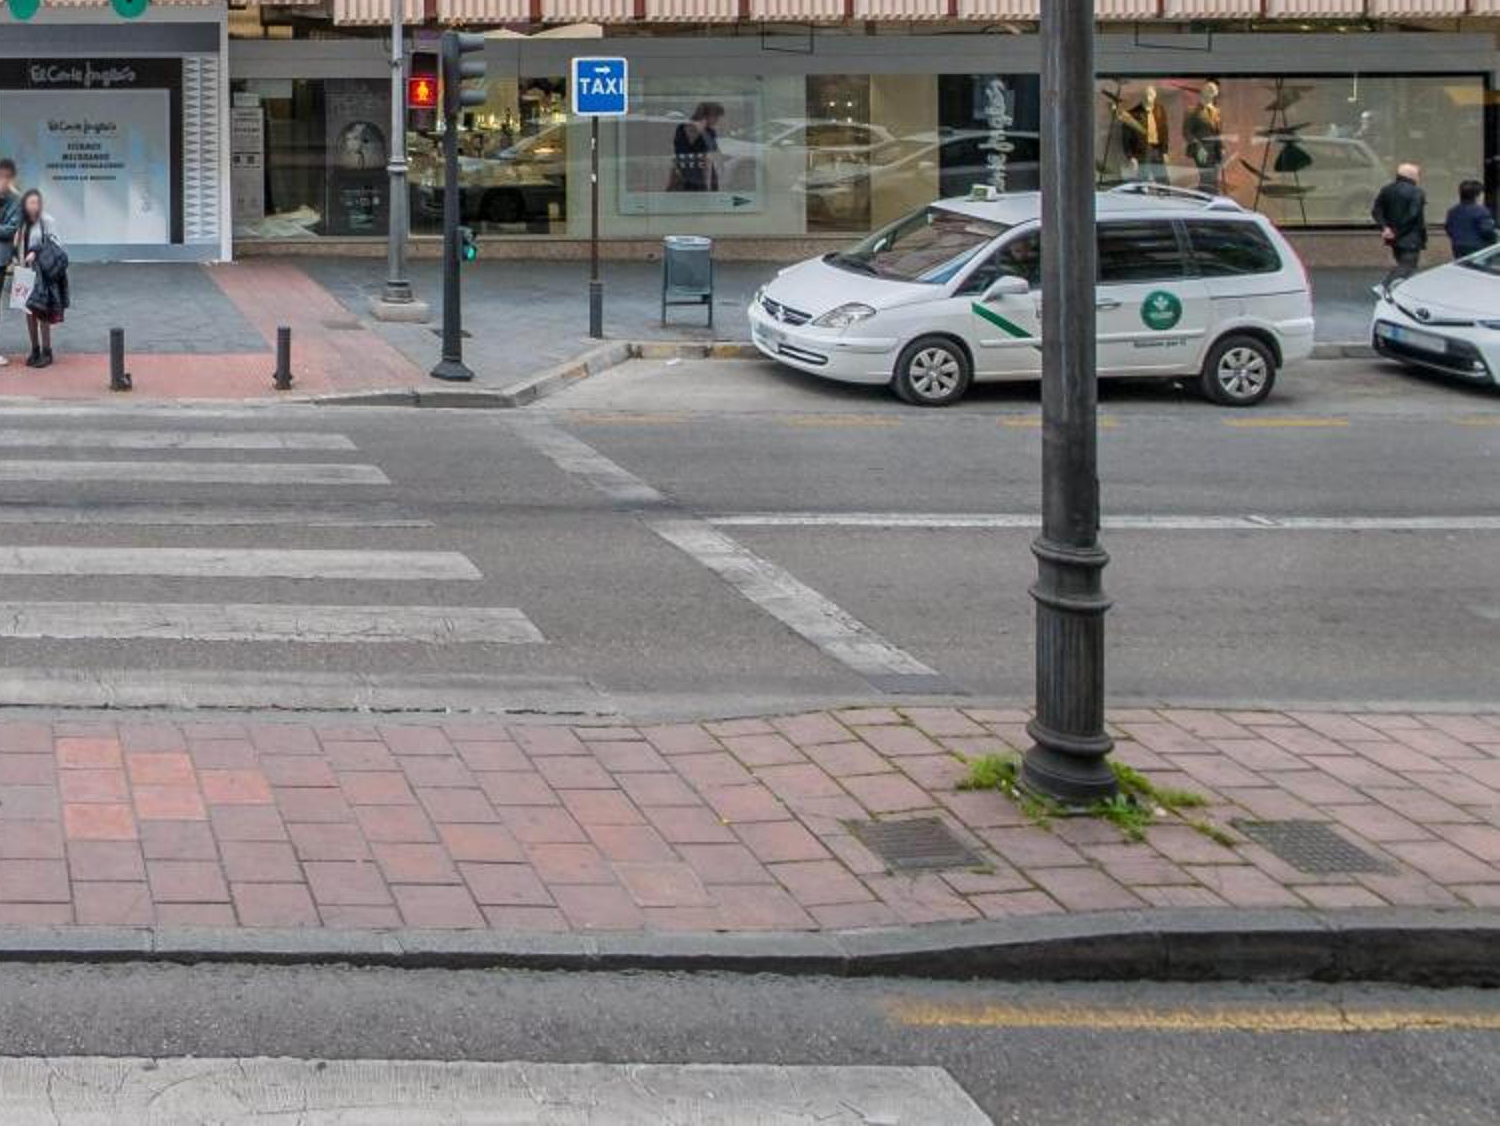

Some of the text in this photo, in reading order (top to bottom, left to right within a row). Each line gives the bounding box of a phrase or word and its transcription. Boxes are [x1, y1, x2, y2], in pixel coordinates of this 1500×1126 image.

[31, 60, 137, 88] El Corte Inglés
[579, 77, 624, 95] TAXI
